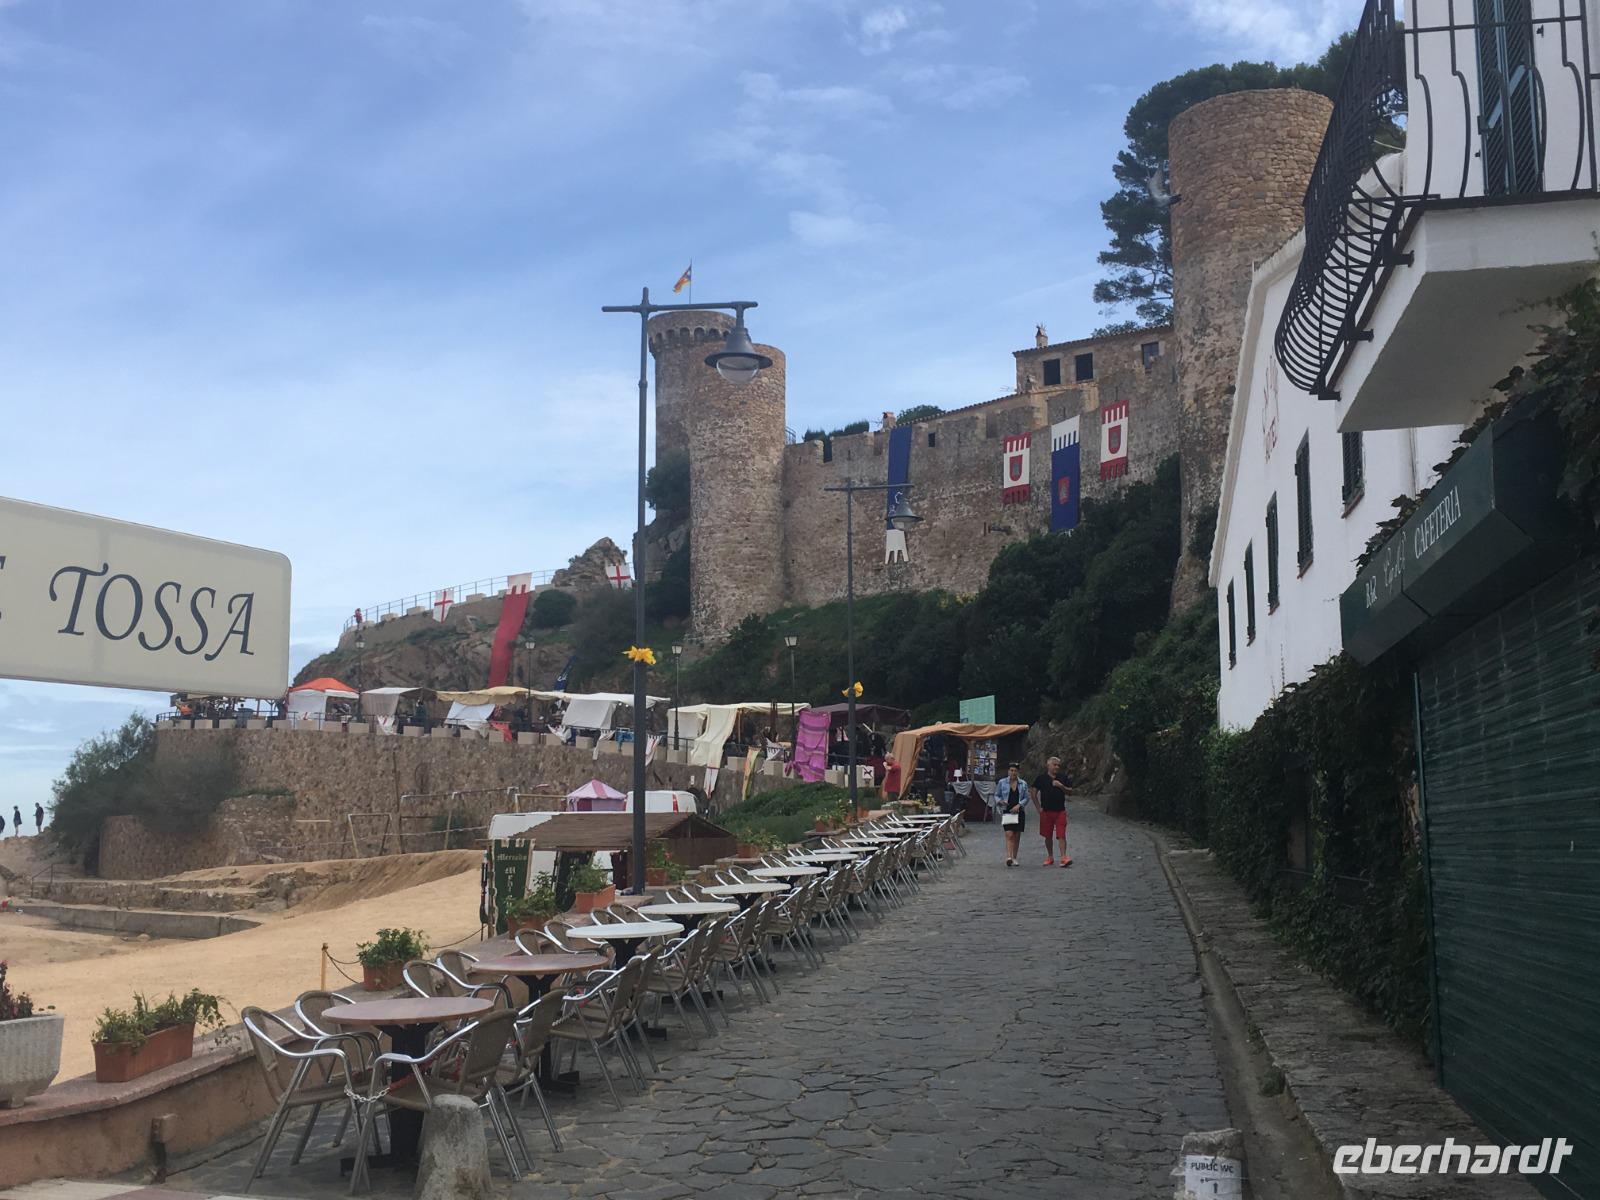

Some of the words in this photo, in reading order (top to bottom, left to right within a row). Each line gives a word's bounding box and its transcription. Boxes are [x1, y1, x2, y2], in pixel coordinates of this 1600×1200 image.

[1414, 485, 1462, 560] CAFETERIA
[48, 562, 255, 662] TOSSA
[1191, 1162, 1219, 1172] PUBLIC
[1220, 1164, 1235, 1174] WC
